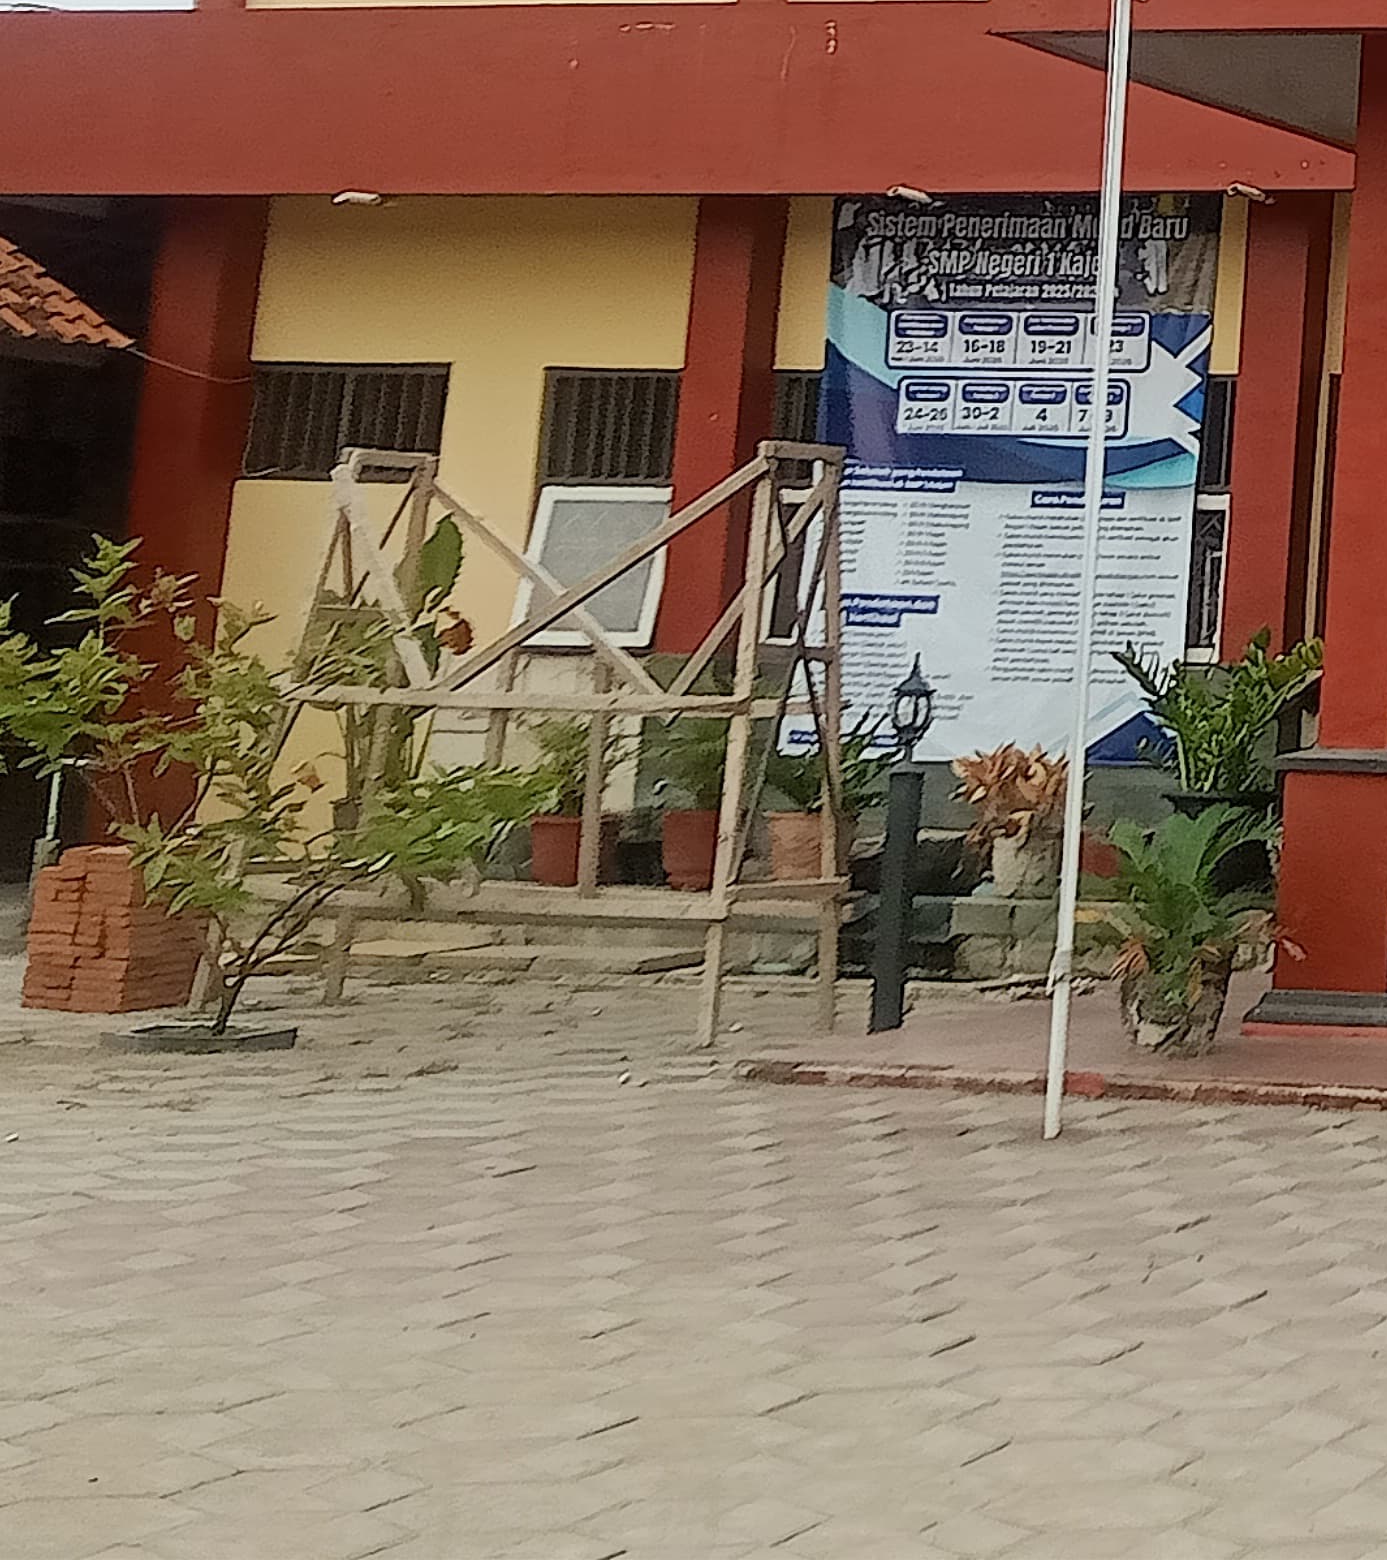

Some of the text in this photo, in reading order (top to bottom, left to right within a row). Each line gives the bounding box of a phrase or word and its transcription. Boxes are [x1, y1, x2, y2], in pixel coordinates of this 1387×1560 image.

[866, 210, 938, 238] Sistem
[942, 211, 1067, 240] Penerimaan
[1138, 214, 1189, 240] Baru
[928, 249, 971, 276] SMP
[975, 250, 1042, 280] Negeri
[1060, 250, 1101, 280] Kaje
